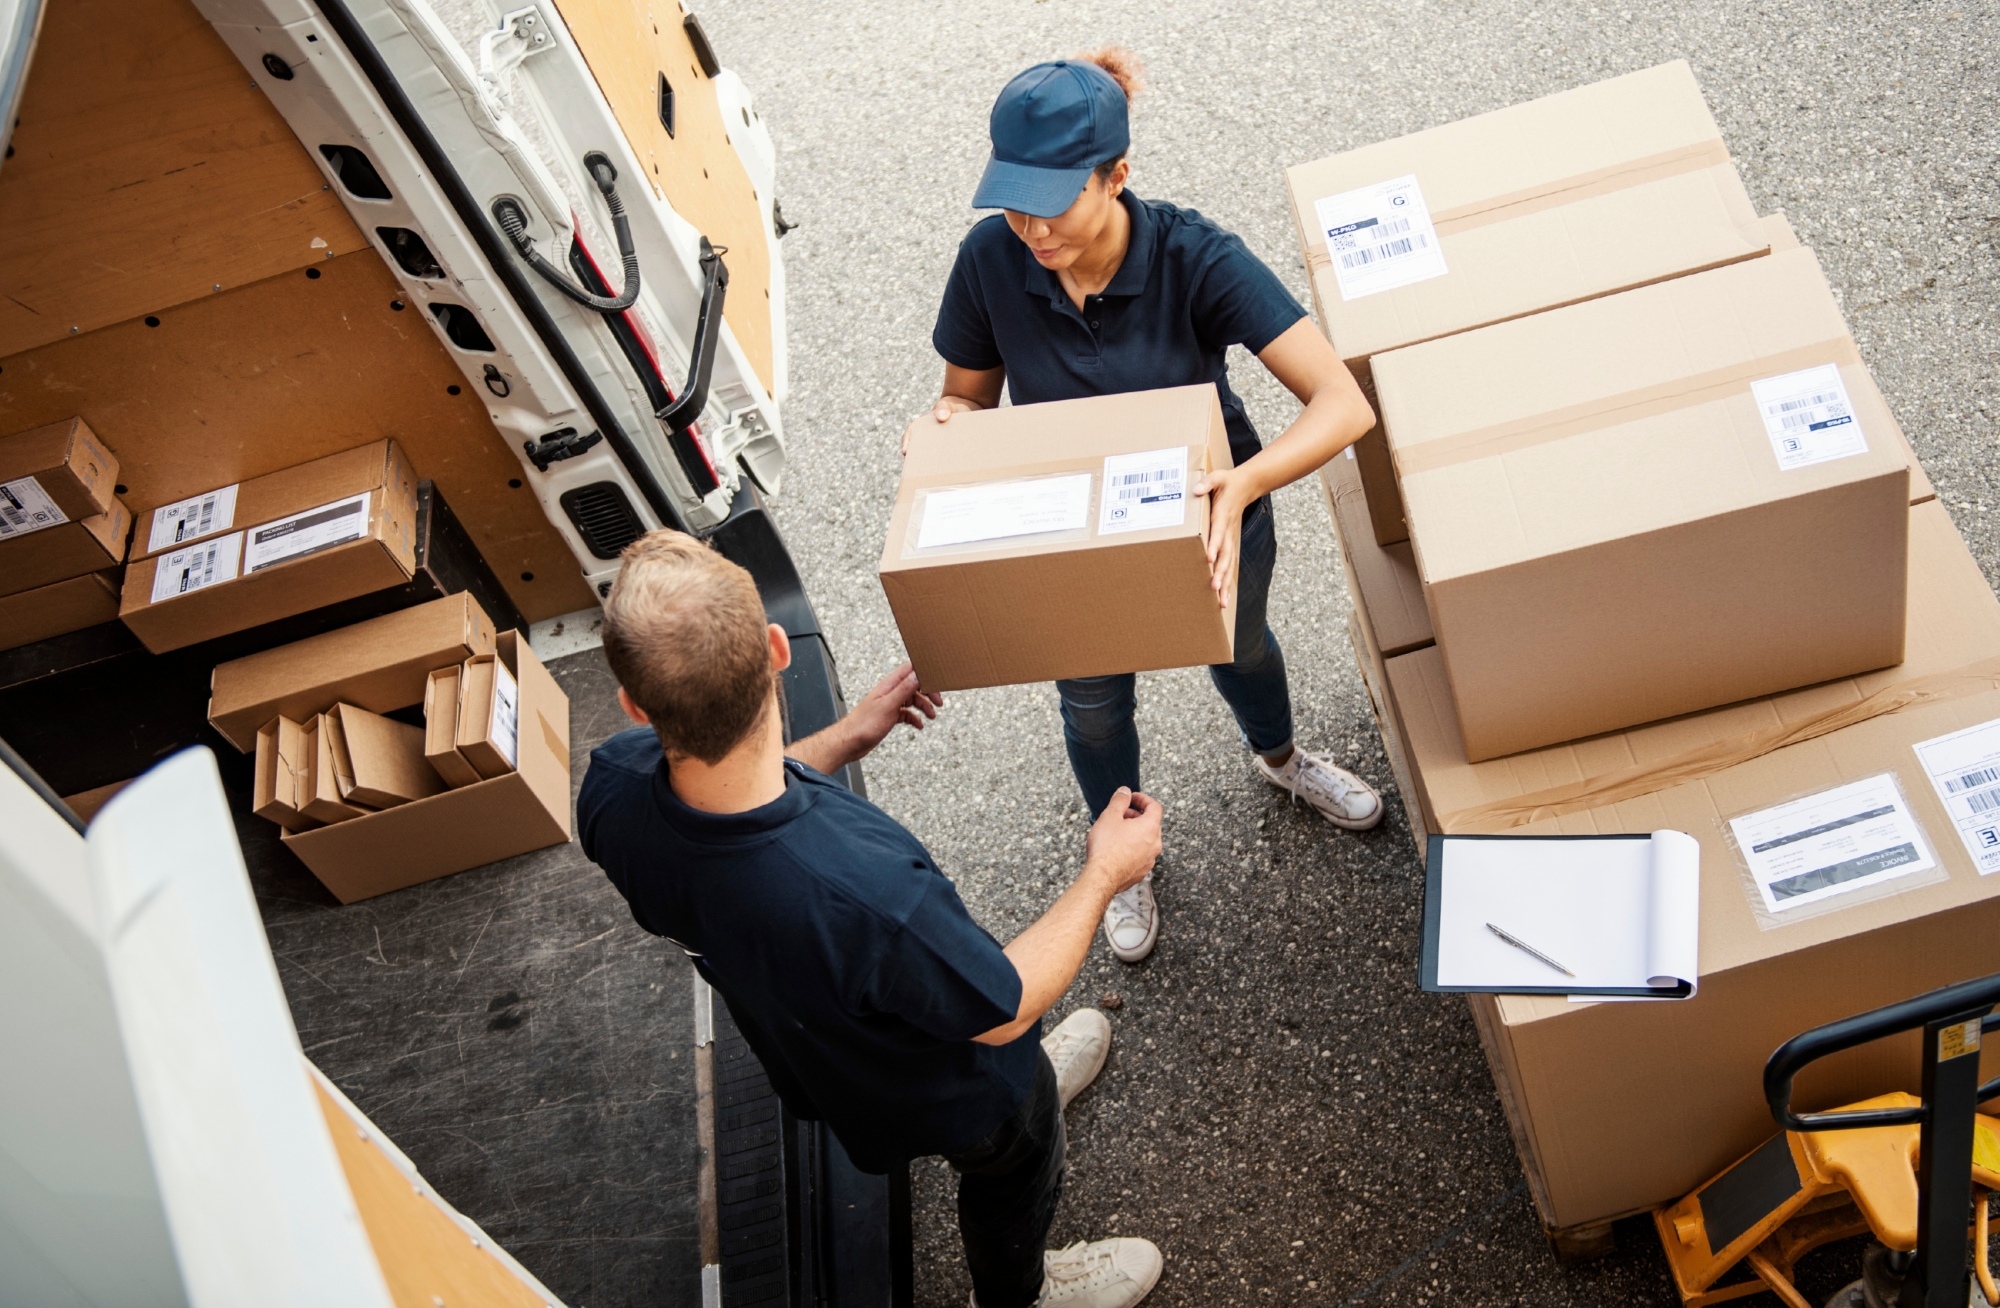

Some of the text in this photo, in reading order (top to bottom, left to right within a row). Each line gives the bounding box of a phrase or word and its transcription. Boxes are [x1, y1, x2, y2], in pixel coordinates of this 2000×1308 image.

[1391, 195, 1405, 206] G
[1787, 440, 1797, 449] E
[34, 512, 47, 520] G
[1114, 509, 1124, 518] G
[1021, 516, 1050, 526] INVOICE
[261, 525, 284, 536] PACKING
[173, 556, 181, 564] E
[1981, 829, 1998, 844] E
[1883, 847, 1906, 857] Invoice
[1878, 854, 1910, 868] INVOICE
